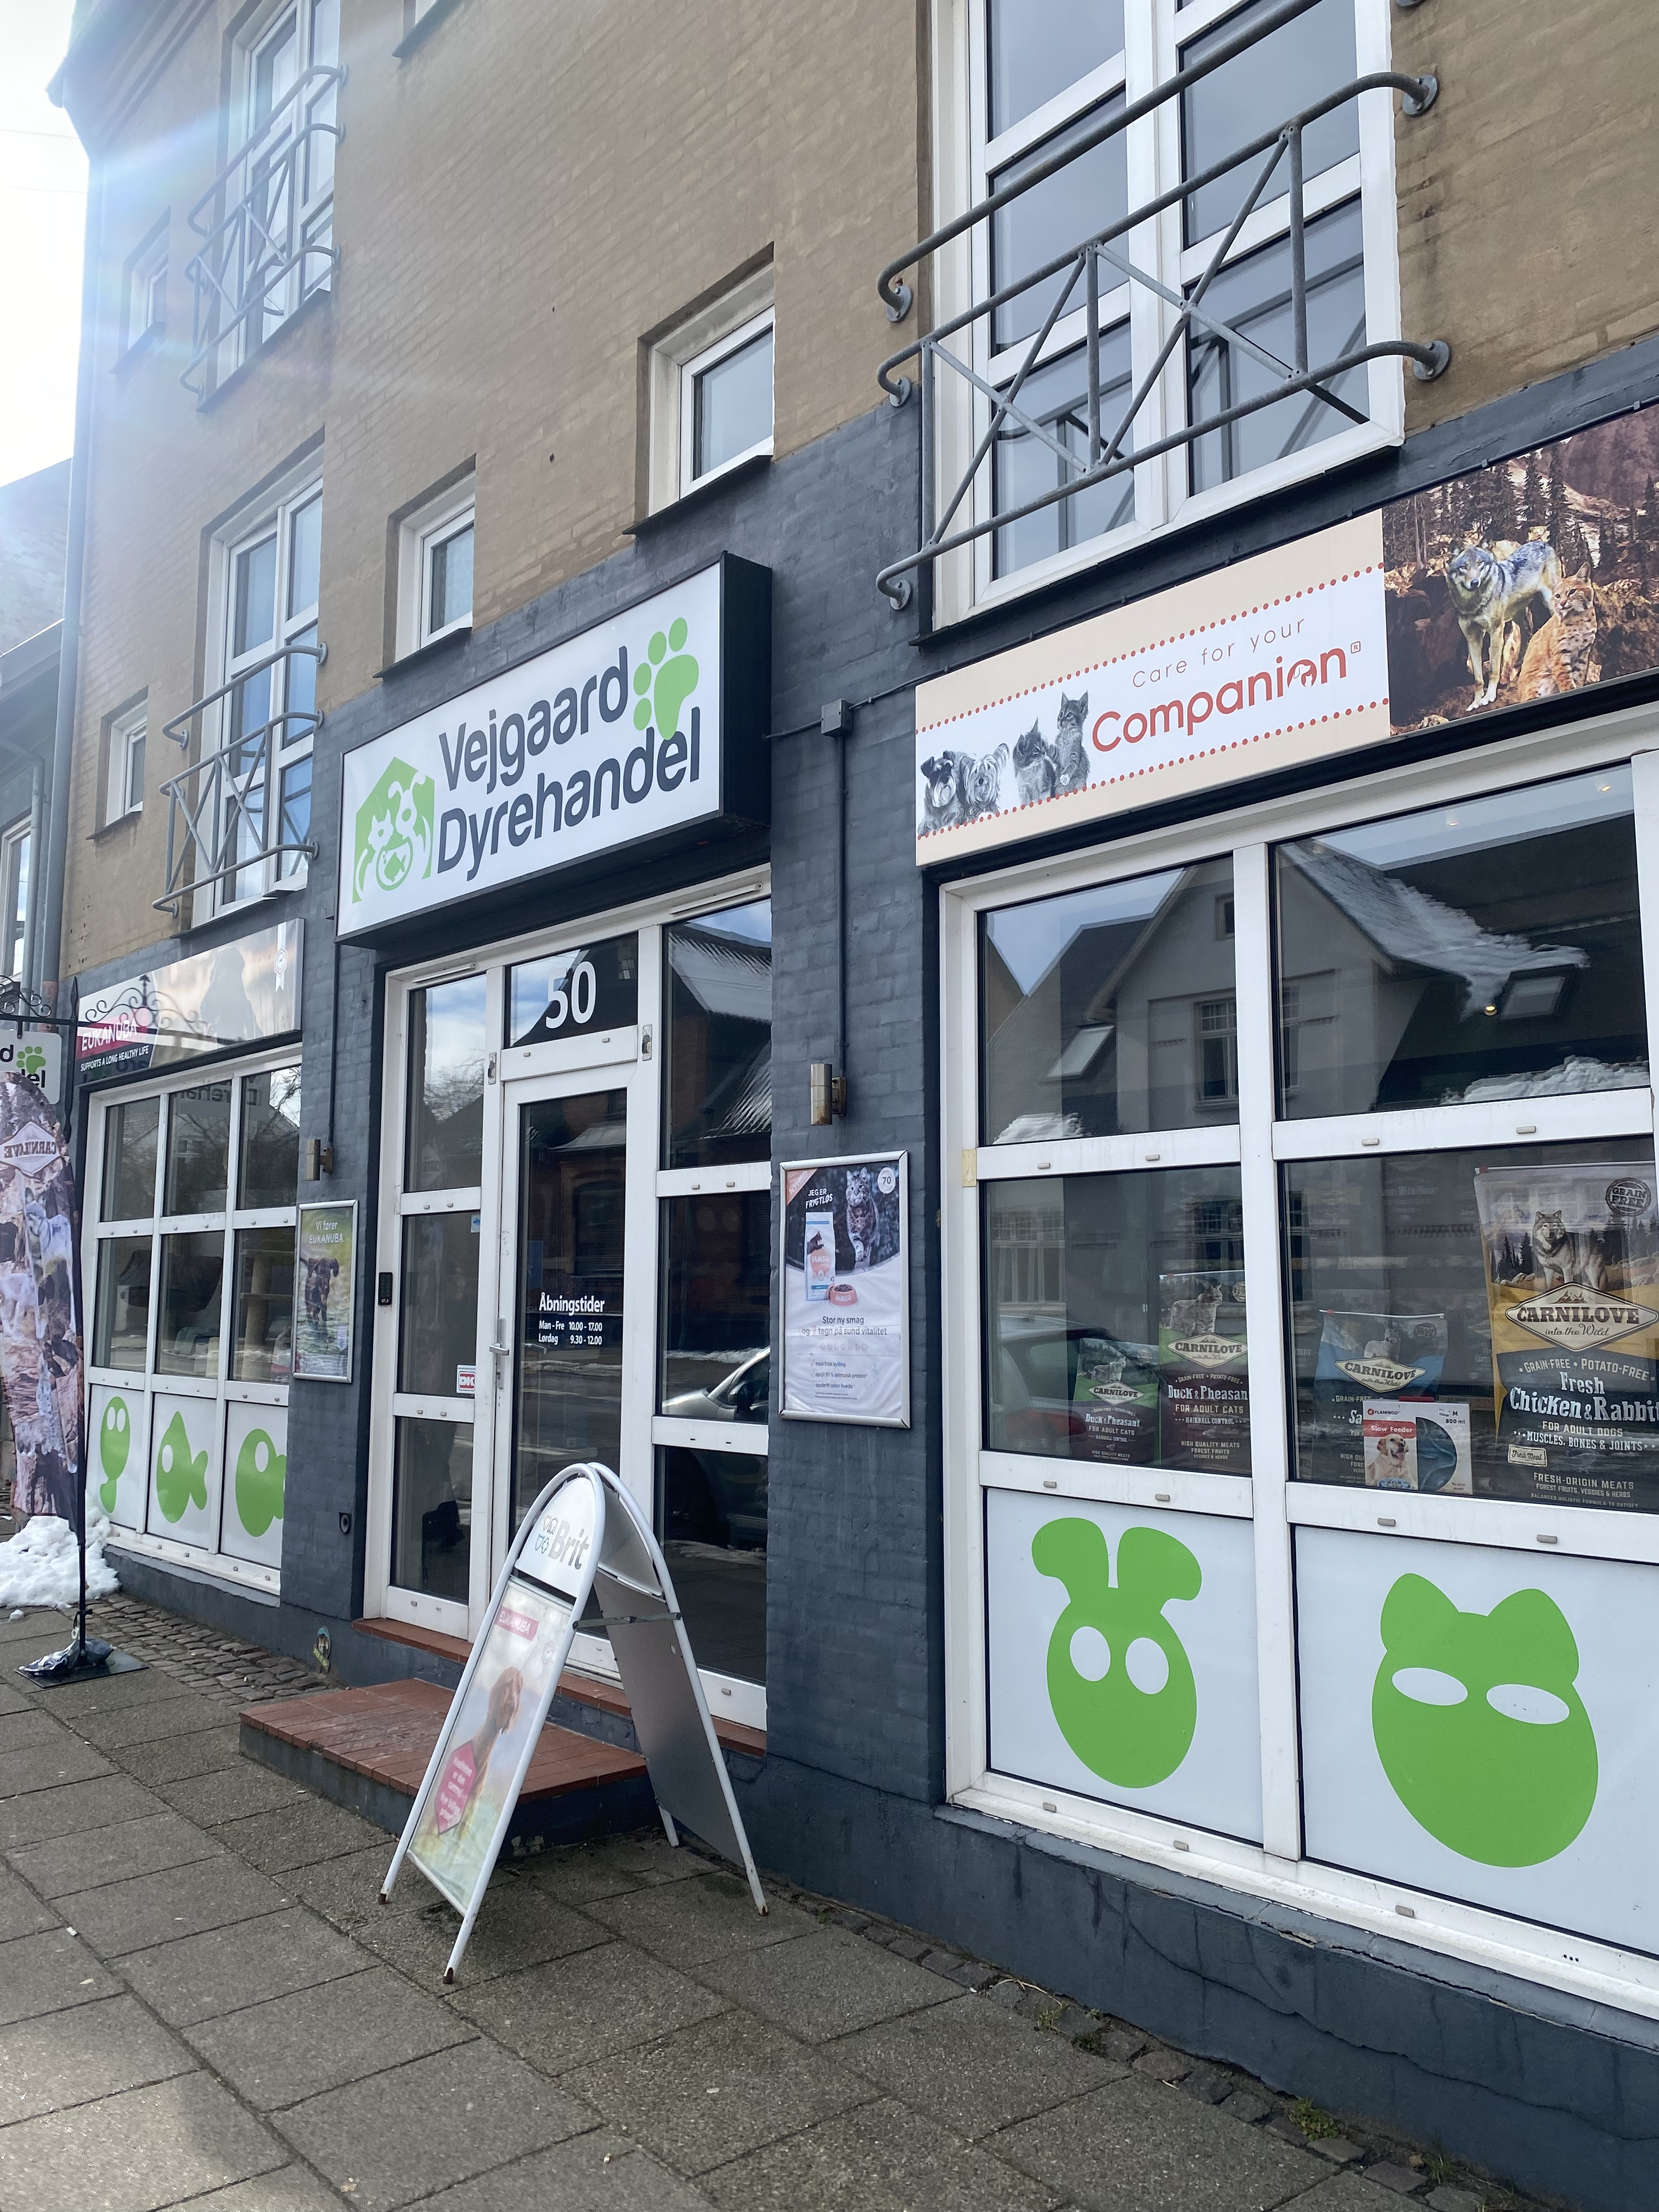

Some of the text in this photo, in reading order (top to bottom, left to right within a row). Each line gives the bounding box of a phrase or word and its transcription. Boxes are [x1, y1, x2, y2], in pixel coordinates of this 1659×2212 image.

[1132, 617, 1305, 688] Care for your
[438, 645, 627, 794] Vejgaard
[437, 707, 701, 881] Dyrehandel
[546, 961, 596, 1029] 50
[81, 1017, 137, 1051] EUKANUBA
[80, 1045, 149, 1072] SUPPORTS A LONG HEALTHY LIFE
[788, 1170, 808, 1195] NYHED
[882, 1176, 891, 1185] 70
[1612, 1187, 1646, 1199] GRAIN
[805, 1193, 833, 1209] FRYGTLØS
[1611, 1195, 1644, 1208] FREE
[315, 1221, 338, 1231] Vi fører
[309, 1233, 343, 1244] EUKANUBA
[539, 1292, 605, 1316] Åbningstider
[1517, 1306, 1639, 1324] CARNILOVE
[539, 1321, 551, 1330] Man
[555, 1321, 565, 1330] Fre
[569, 1322, 583, 1331] 10.00
[588, 1322, 602, 1331] 17.00
[802, 1328, 810, 1336] og
[818, 1327, 833, 1336] tegn
[834, 1325, 842, 1336] på
[844, 1327, 860, 1335] sund
[861, 1327, 887, 1335] vitalitet
[1545, 1323, 1610, 1336] into the Wild
[538, 1333, 558, 1345] Lørdag
[570, 1335, 583, 1344] 9.30
[587, 1335, 602, 1345] 12.00
[1175, 1342, 1242, 1354] CARNILOVE
[1344, 1362, 1416, 1380] CARNILOVE
[1523, 1358, 1649, 1381] GRAIN-FREE POTATO-FREE
[1178, 1373, 1240, 1384] GRAIN-FREE POTATO-FREE
[1559, 1372, 1605, 1395] Fresh
[1093, 1387, 1138, 1398] CARNILOVE
[1167, 1385, 1249, 1400] Duck & Pheasan
[1193, 1405, 1219, 1413] ADULT
[1222, 1406, 1244, 1414] CATS
[1509, 1386, 1659, 1422] Chicken & Rabbit
[1085, 1413, 1103, 1424] Duck
[1107, 1415, 1140, 1427] Pheasant
[1542, 1421, 1623, 1437] FOR ADULT DOGS
[1568, 1437, 1596, 1449] BONES
[1599, 1440, 1606, 1450] &
[1609, 1440, 1643, 1451] JOINTS
[1512, 1450, 1527, 1459] Fresh
[1533, 1472, 1634, 1490] FRESH-ORIGIN MEATS
[1536, 1483, 1556, 1491] FOREST
[1581, 1488, 1605, 1496] VEGGIES
[1531, 1493, 1557, 1501] BALANCED
[1582, 1498, 1607, 1506] FORMULA
[548, 1520, 589, 1570] Brit
[499, 1610, 530, 1635] EUKANUBA
